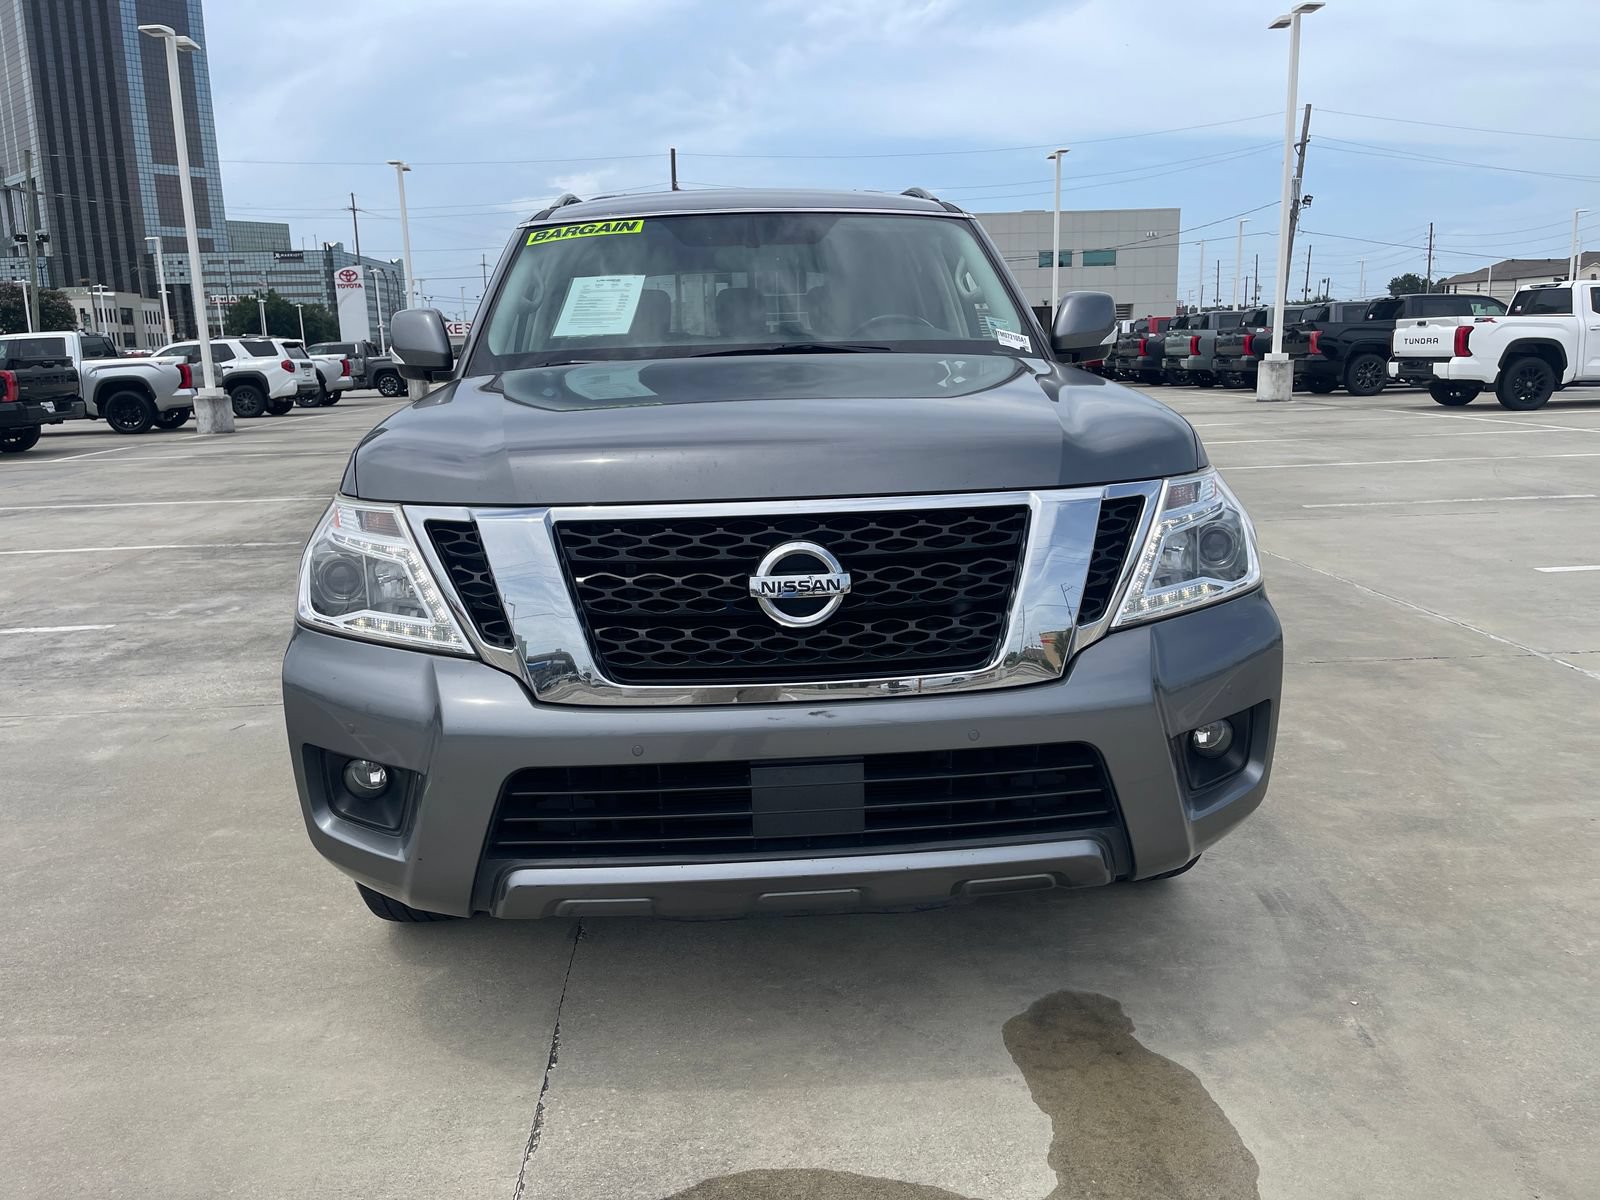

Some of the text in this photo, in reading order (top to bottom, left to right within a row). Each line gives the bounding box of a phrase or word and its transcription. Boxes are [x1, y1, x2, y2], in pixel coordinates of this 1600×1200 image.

[532, 221, 638, 241] BARGAIN
[1404, 337, 1439, 345] TUNDRA
[761, 578, 840, 594] NISSAN
